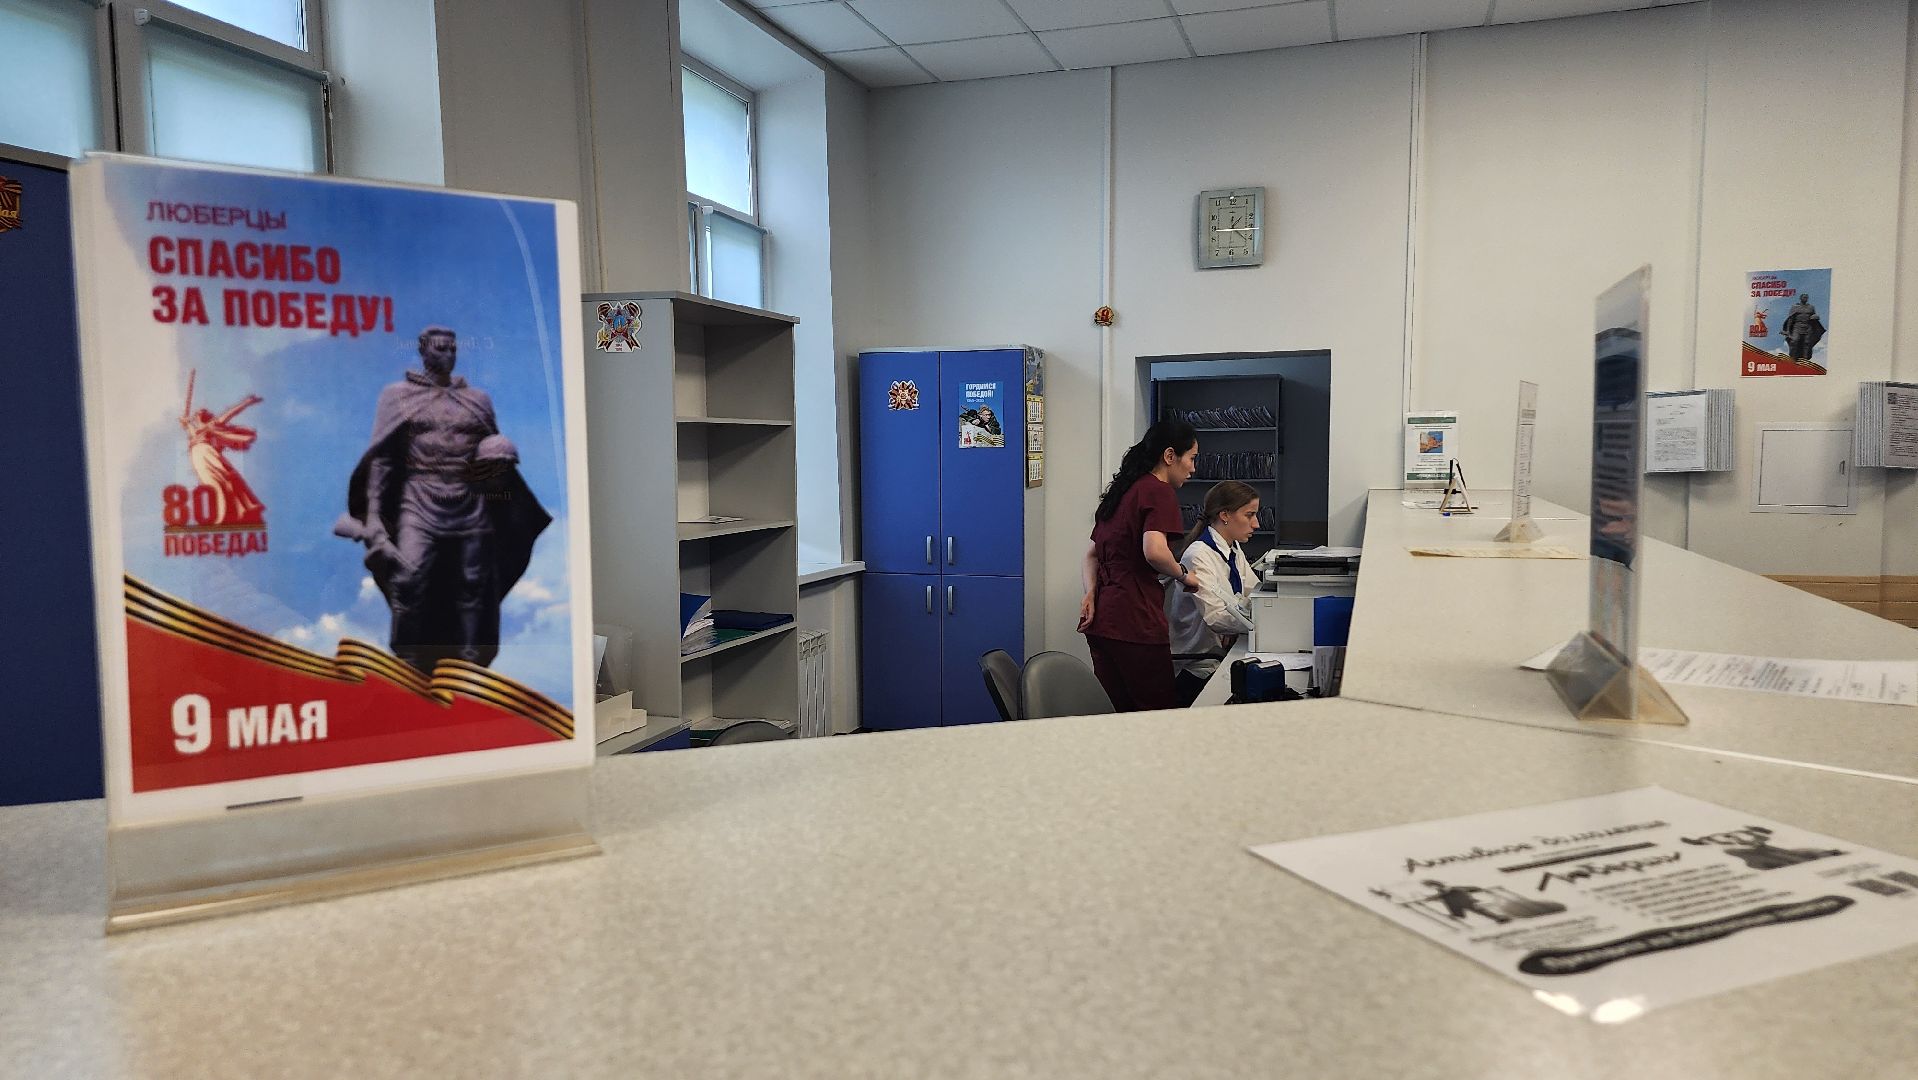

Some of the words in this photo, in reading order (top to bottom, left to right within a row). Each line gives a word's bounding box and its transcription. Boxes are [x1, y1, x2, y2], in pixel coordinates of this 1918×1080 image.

[147, 201, 287, 231] ЛЮБЕРЦЫ
[148, 235, 341, 285] СПАСИБО
[1750, 290, 1761, 298] ЗА
[1763, 288, 1797, 298] ПОБЕДУ!
[1751, 281, 1788, 290] СПАСИБО
[152, 285, 209, 325] ЗА
[222, 288, 395, 338] ПОБЕДУ!
[1747, 361, 1755, 373] 9
[1756, 363, 1777, 372] МАЯ
[965, 383, 996, 391] ГОРДИМСЯ
[965, 390, 994, 398] ПОБЕДОЙ!
[163, 484, 219, 526] 80
[164, 531, 269, 558] ПОБЕДА!
[171, 693, 212, 755] 9
[226, 699, 328, 749] МАЯ
